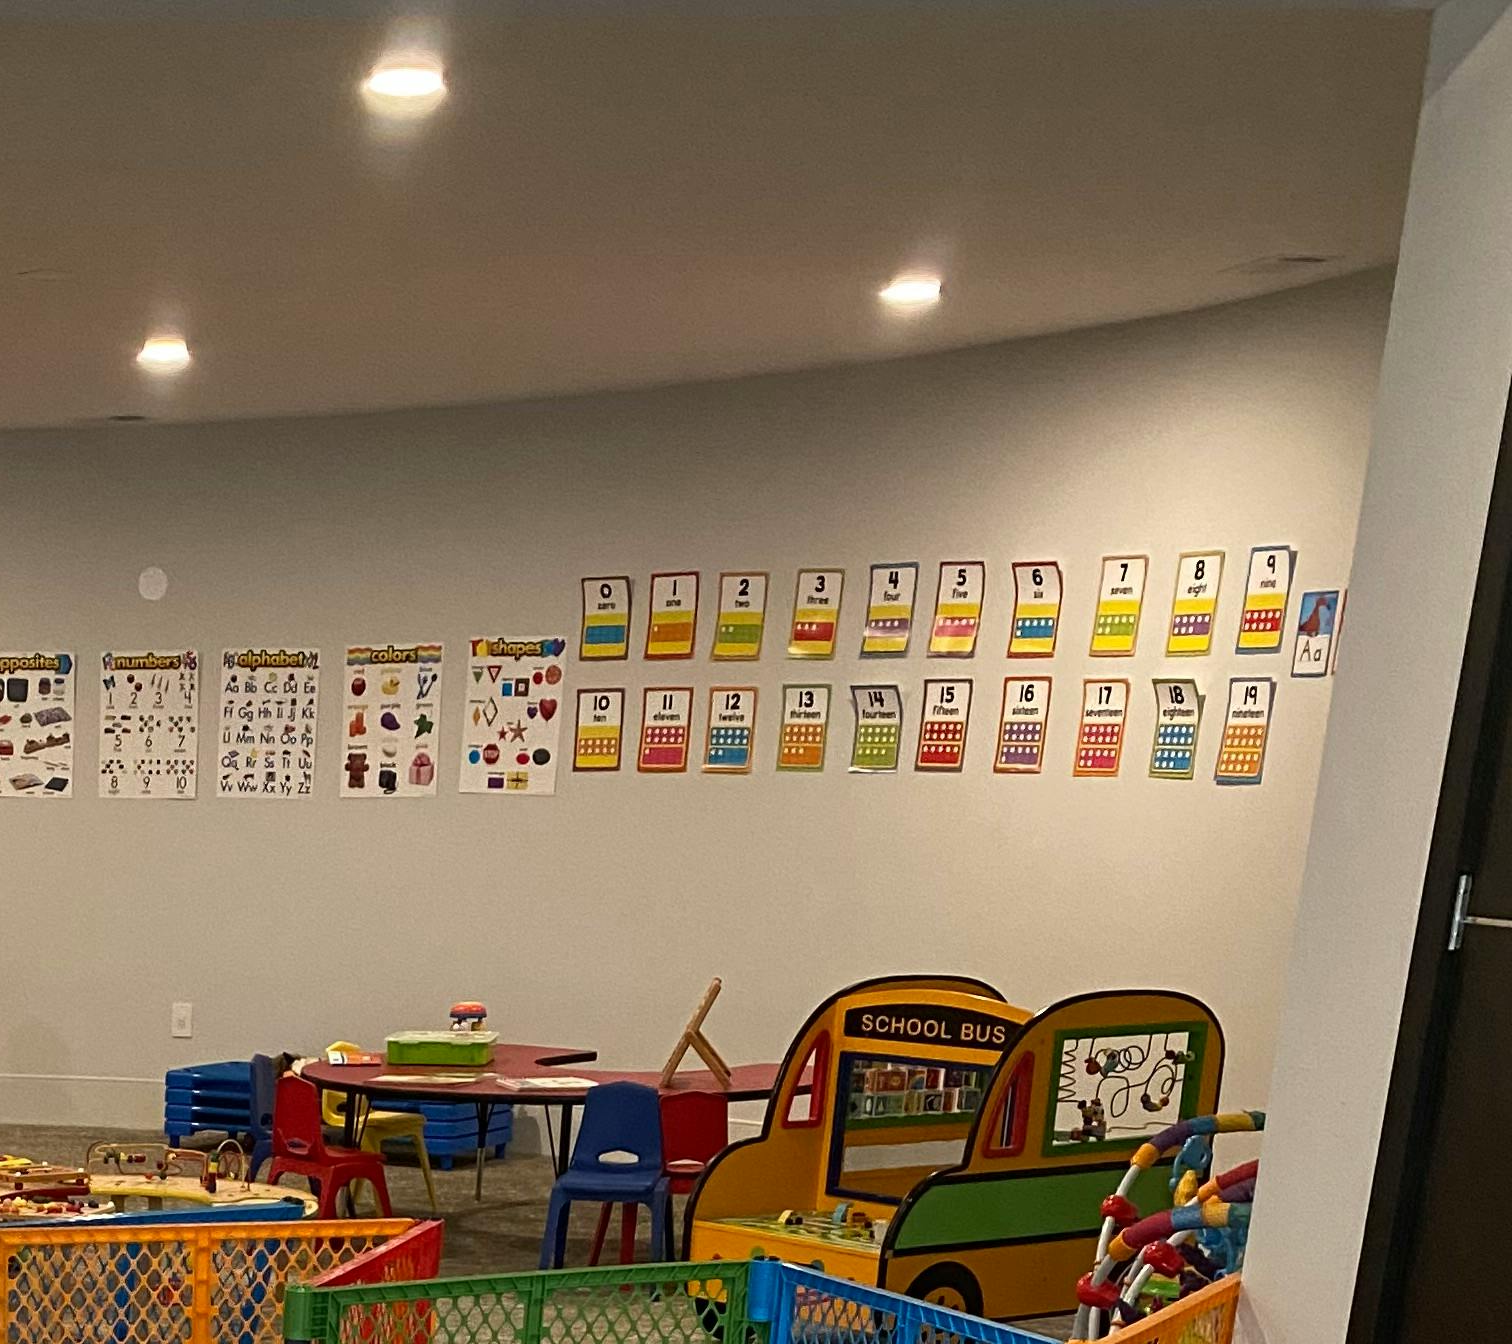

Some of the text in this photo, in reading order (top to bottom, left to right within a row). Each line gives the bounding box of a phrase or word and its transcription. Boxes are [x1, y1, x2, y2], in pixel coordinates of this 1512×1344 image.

[1120, 563, 1128, 582] 7
[1194, 560, 1205, 580] 8
[1267, 555, 1276, 574] 9
[815, 575, 826, 593] 3
[888, 571, 899, 589] 4
[956, 569, 967, 586] 5
[1032, 568, 1044, 586] 6
[1260, 580, 1276, 588] nine
[600, 583, 612, 599] 0
[672, 579, 677, 596] 1
[738, 579, 748, 596] 2
[952, 588, 968, 599] five
[1111, 587, 1133, 595] seven
[1188, 584, 1207, 597] eight
[666, 599, 681, 607] one
[735, 600, 750, 608] two
[807, 596, 829, 604] three
[884, 591, 900, 601] four
[371, 646, 417, 662] colors
[493, 639, 541, 659] shapes
[1300, 639, 1322, 661] Aa
[116, 653, 180, 669] numbers
[238, 651, 305, 671] alphabet
[109, 692, 191, 704] 1 2 3 4
[798, 691, 814, 707] 13
[868, 691, 884, 707] 14
[940, 686, 954, 704] 15
[1020, 684, 1034, 702] 16
[1098, 686, 1112, 704] 17
[1168, 685, 1184, 704] 18
[1244, 685, 1258, 705] 19
[593, 695, 610, 710] 10
[663, 694, 673, 710] 11
[726, 693, 741, 710] 12
[653, 713, 680, 721] eleven
[719, 713, 745, 722] twelve
[790, 709, 820, 718] thirteen
[862, 709, 896, 719] fourteen
[115, 735, 185, 747] 5 6 7
[111, 776, 187, 789] 8 9 10
[861, 1014, 1006, 1044] SCHOOL BUS
